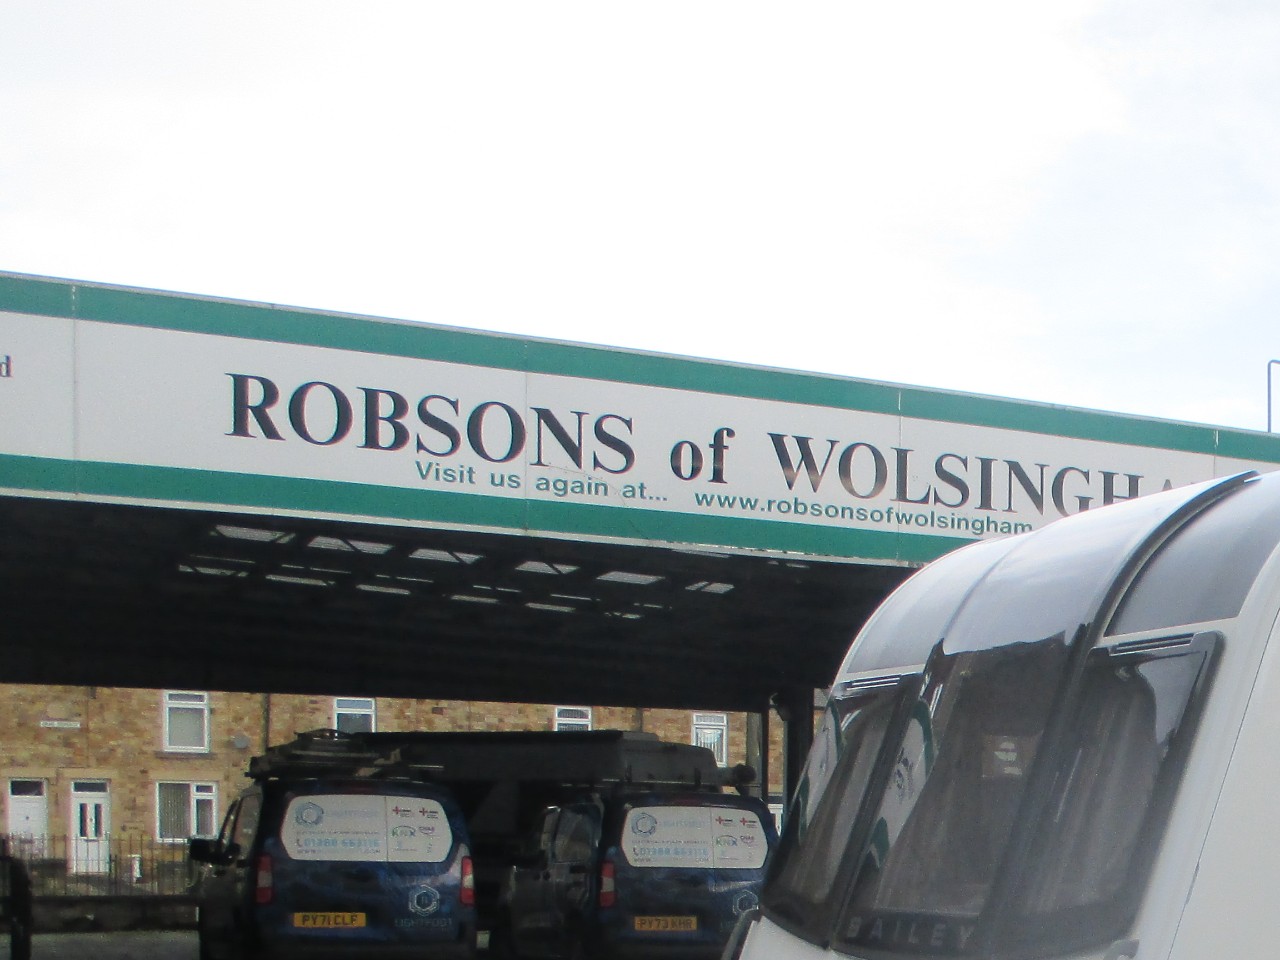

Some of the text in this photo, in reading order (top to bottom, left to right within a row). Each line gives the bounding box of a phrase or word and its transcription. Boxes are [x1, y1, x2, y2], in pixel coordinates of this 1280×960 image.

[223, 372, 1195, 517] ROBSONS of WOLSINGH
[414, 460, 476, 485] Visit
[489, 472, 522, 489] us
[534, 475, 609, 497] again
[621, 481, 668, 502] at...
[847, 915, 976, 950] BAILEY
